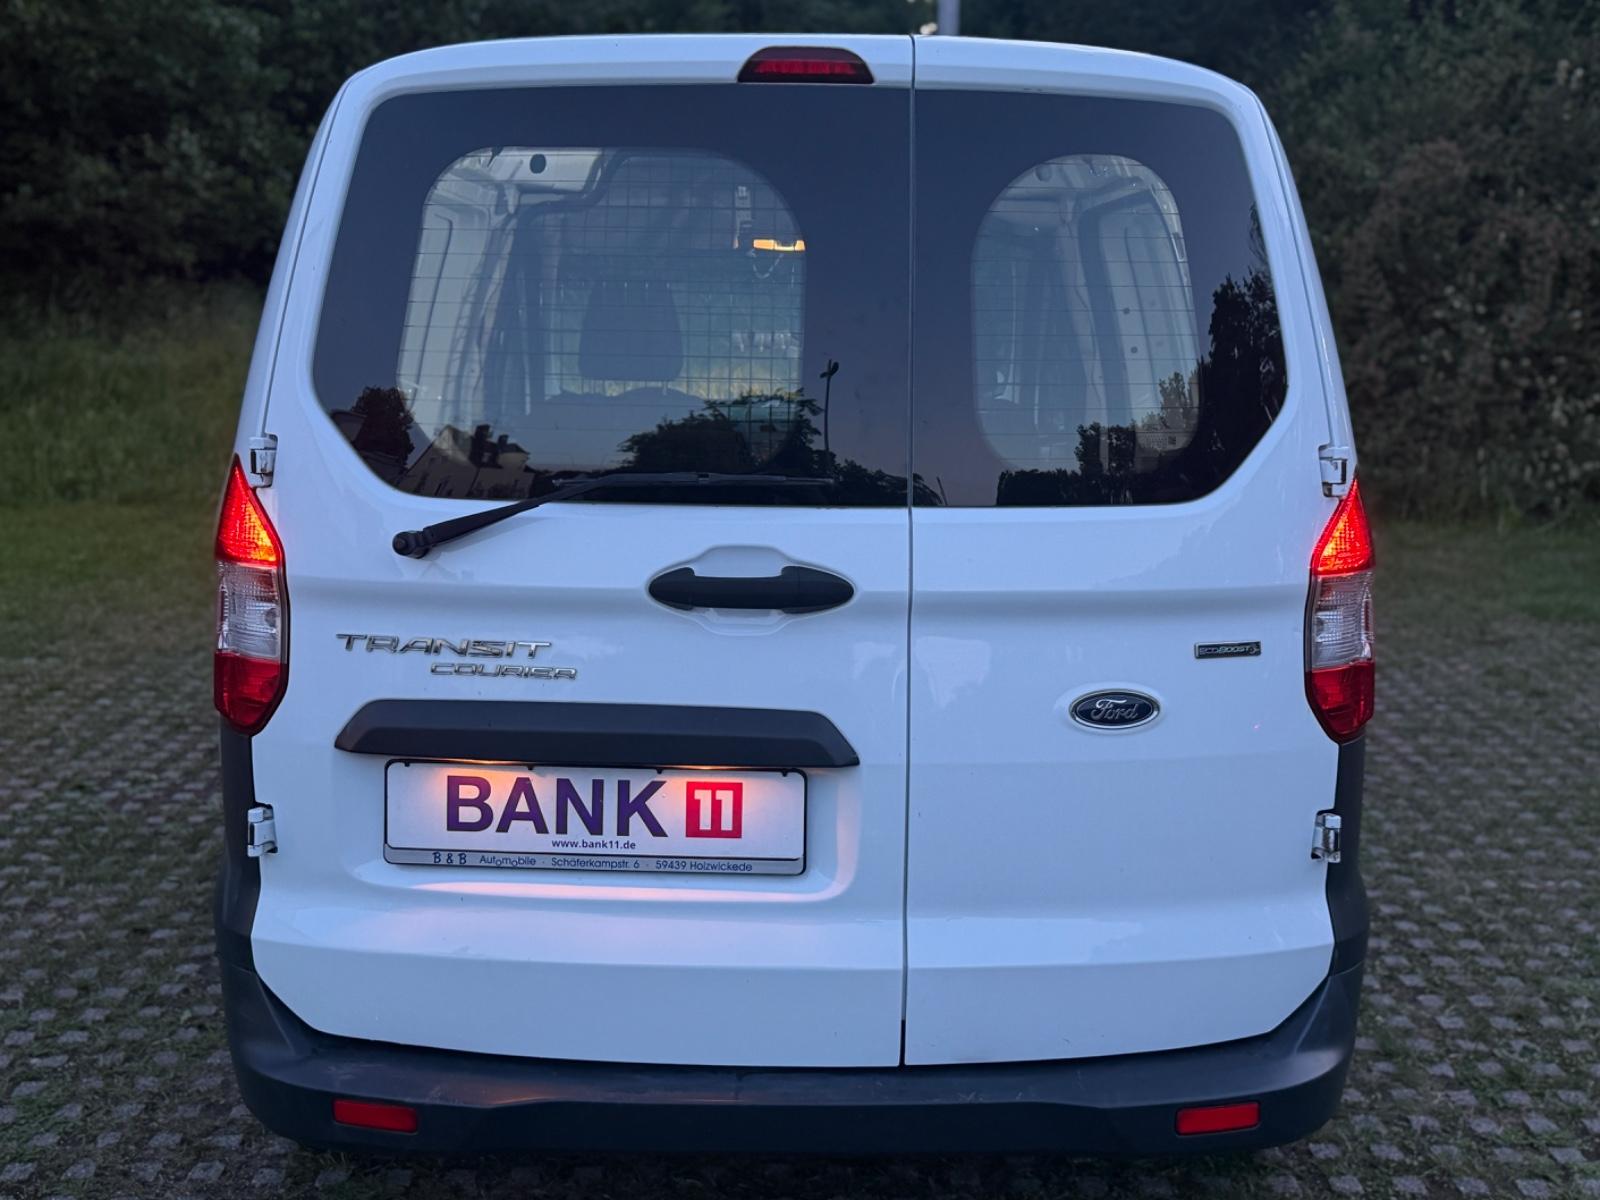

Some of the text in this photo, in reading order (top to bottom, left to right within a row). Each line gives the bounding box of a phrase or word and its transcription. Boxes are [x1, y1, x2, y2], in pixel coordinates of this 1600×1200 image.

[336, 633, 552, 659] TRANSIT
[430, 662, 578, 681] COURIER
[1090, 699, 1139, 720] Ford
[446, 775, 734, 837] BANK 11
[551, 839, 637, 850] www.bank11.de
[432, 852, 442, 864] B
[446, 853, 454, 864] &
[457, 853, 468, 865] B
[479, 855, 537, 867] Automobile
[633, 860, 640, 869] 6
[655, 860, 687, 870] 59439
[689, 861, 753, 872] Holzwickede
